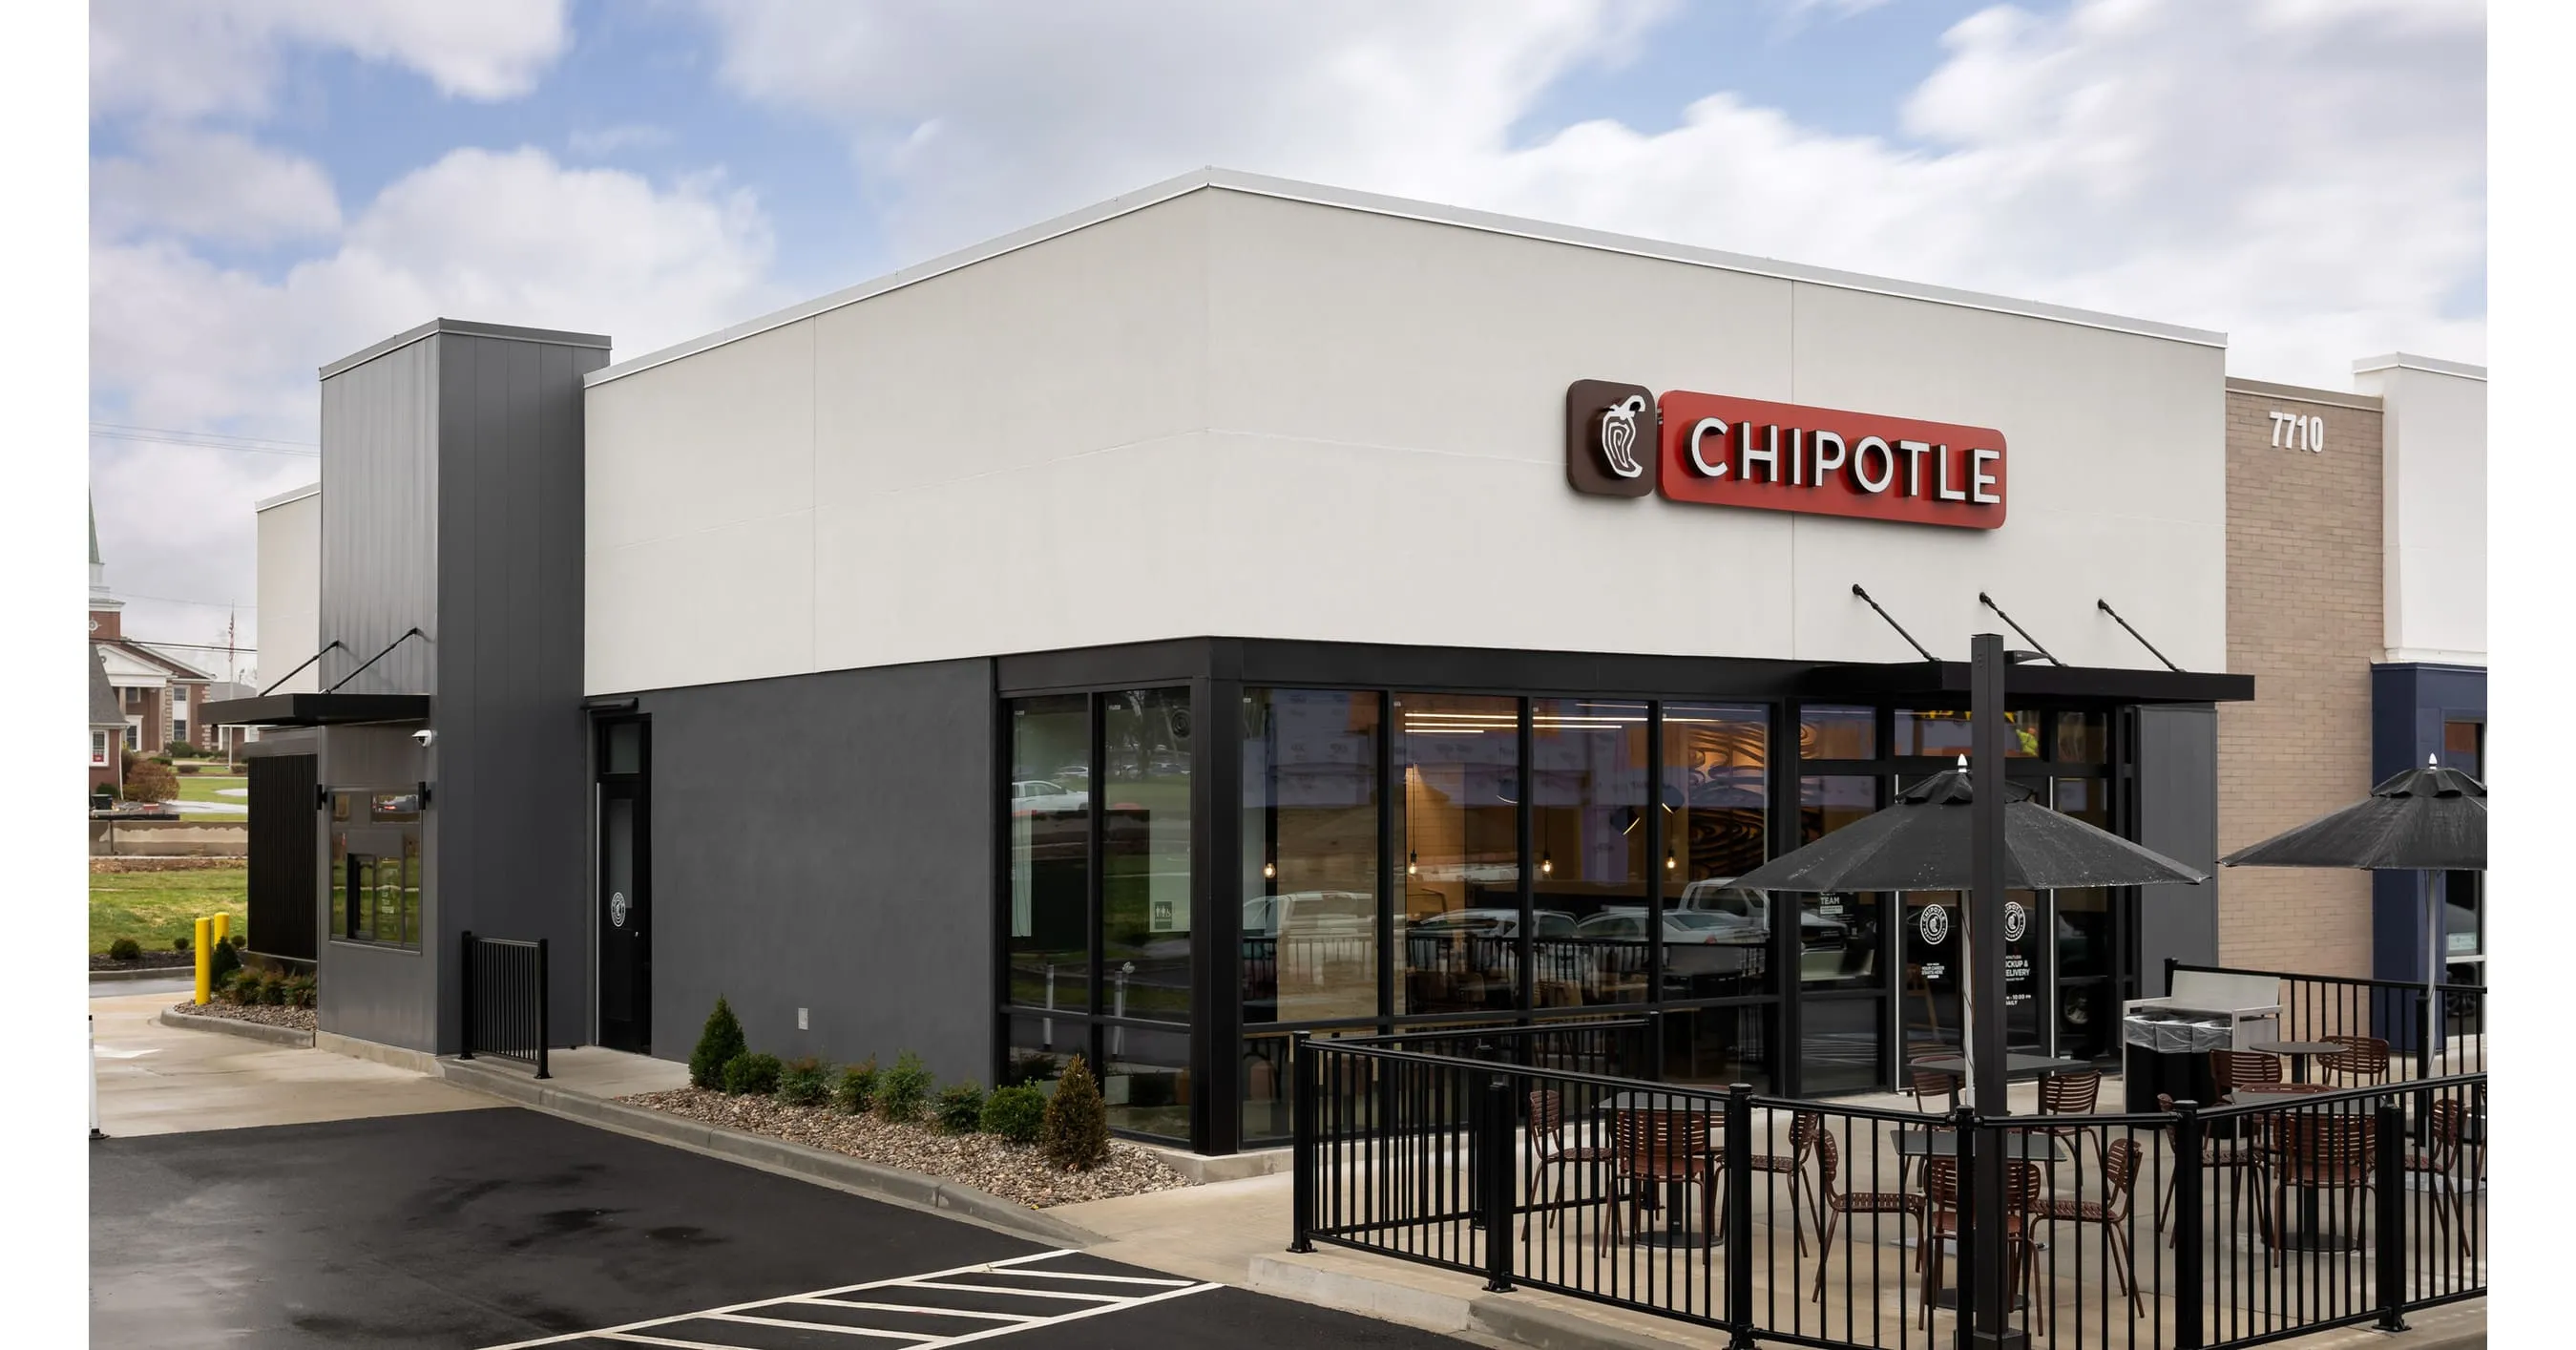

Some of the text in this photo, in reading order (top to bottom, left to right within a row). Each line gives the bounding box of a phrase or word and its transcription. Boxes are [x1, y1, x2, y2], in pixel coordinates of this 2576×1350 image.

[2269, 411, 2324, 454] 7710
[1688, 416, 2001, 505] CHIPOTLE
[1820, 896, 1840, 905] TEAM
[1922, 906, 1946, 922] CHIPOTLE
[2005, 960, 2023, 968] ICKUP
[2005, 968, 2030, 977] ELIVERY
